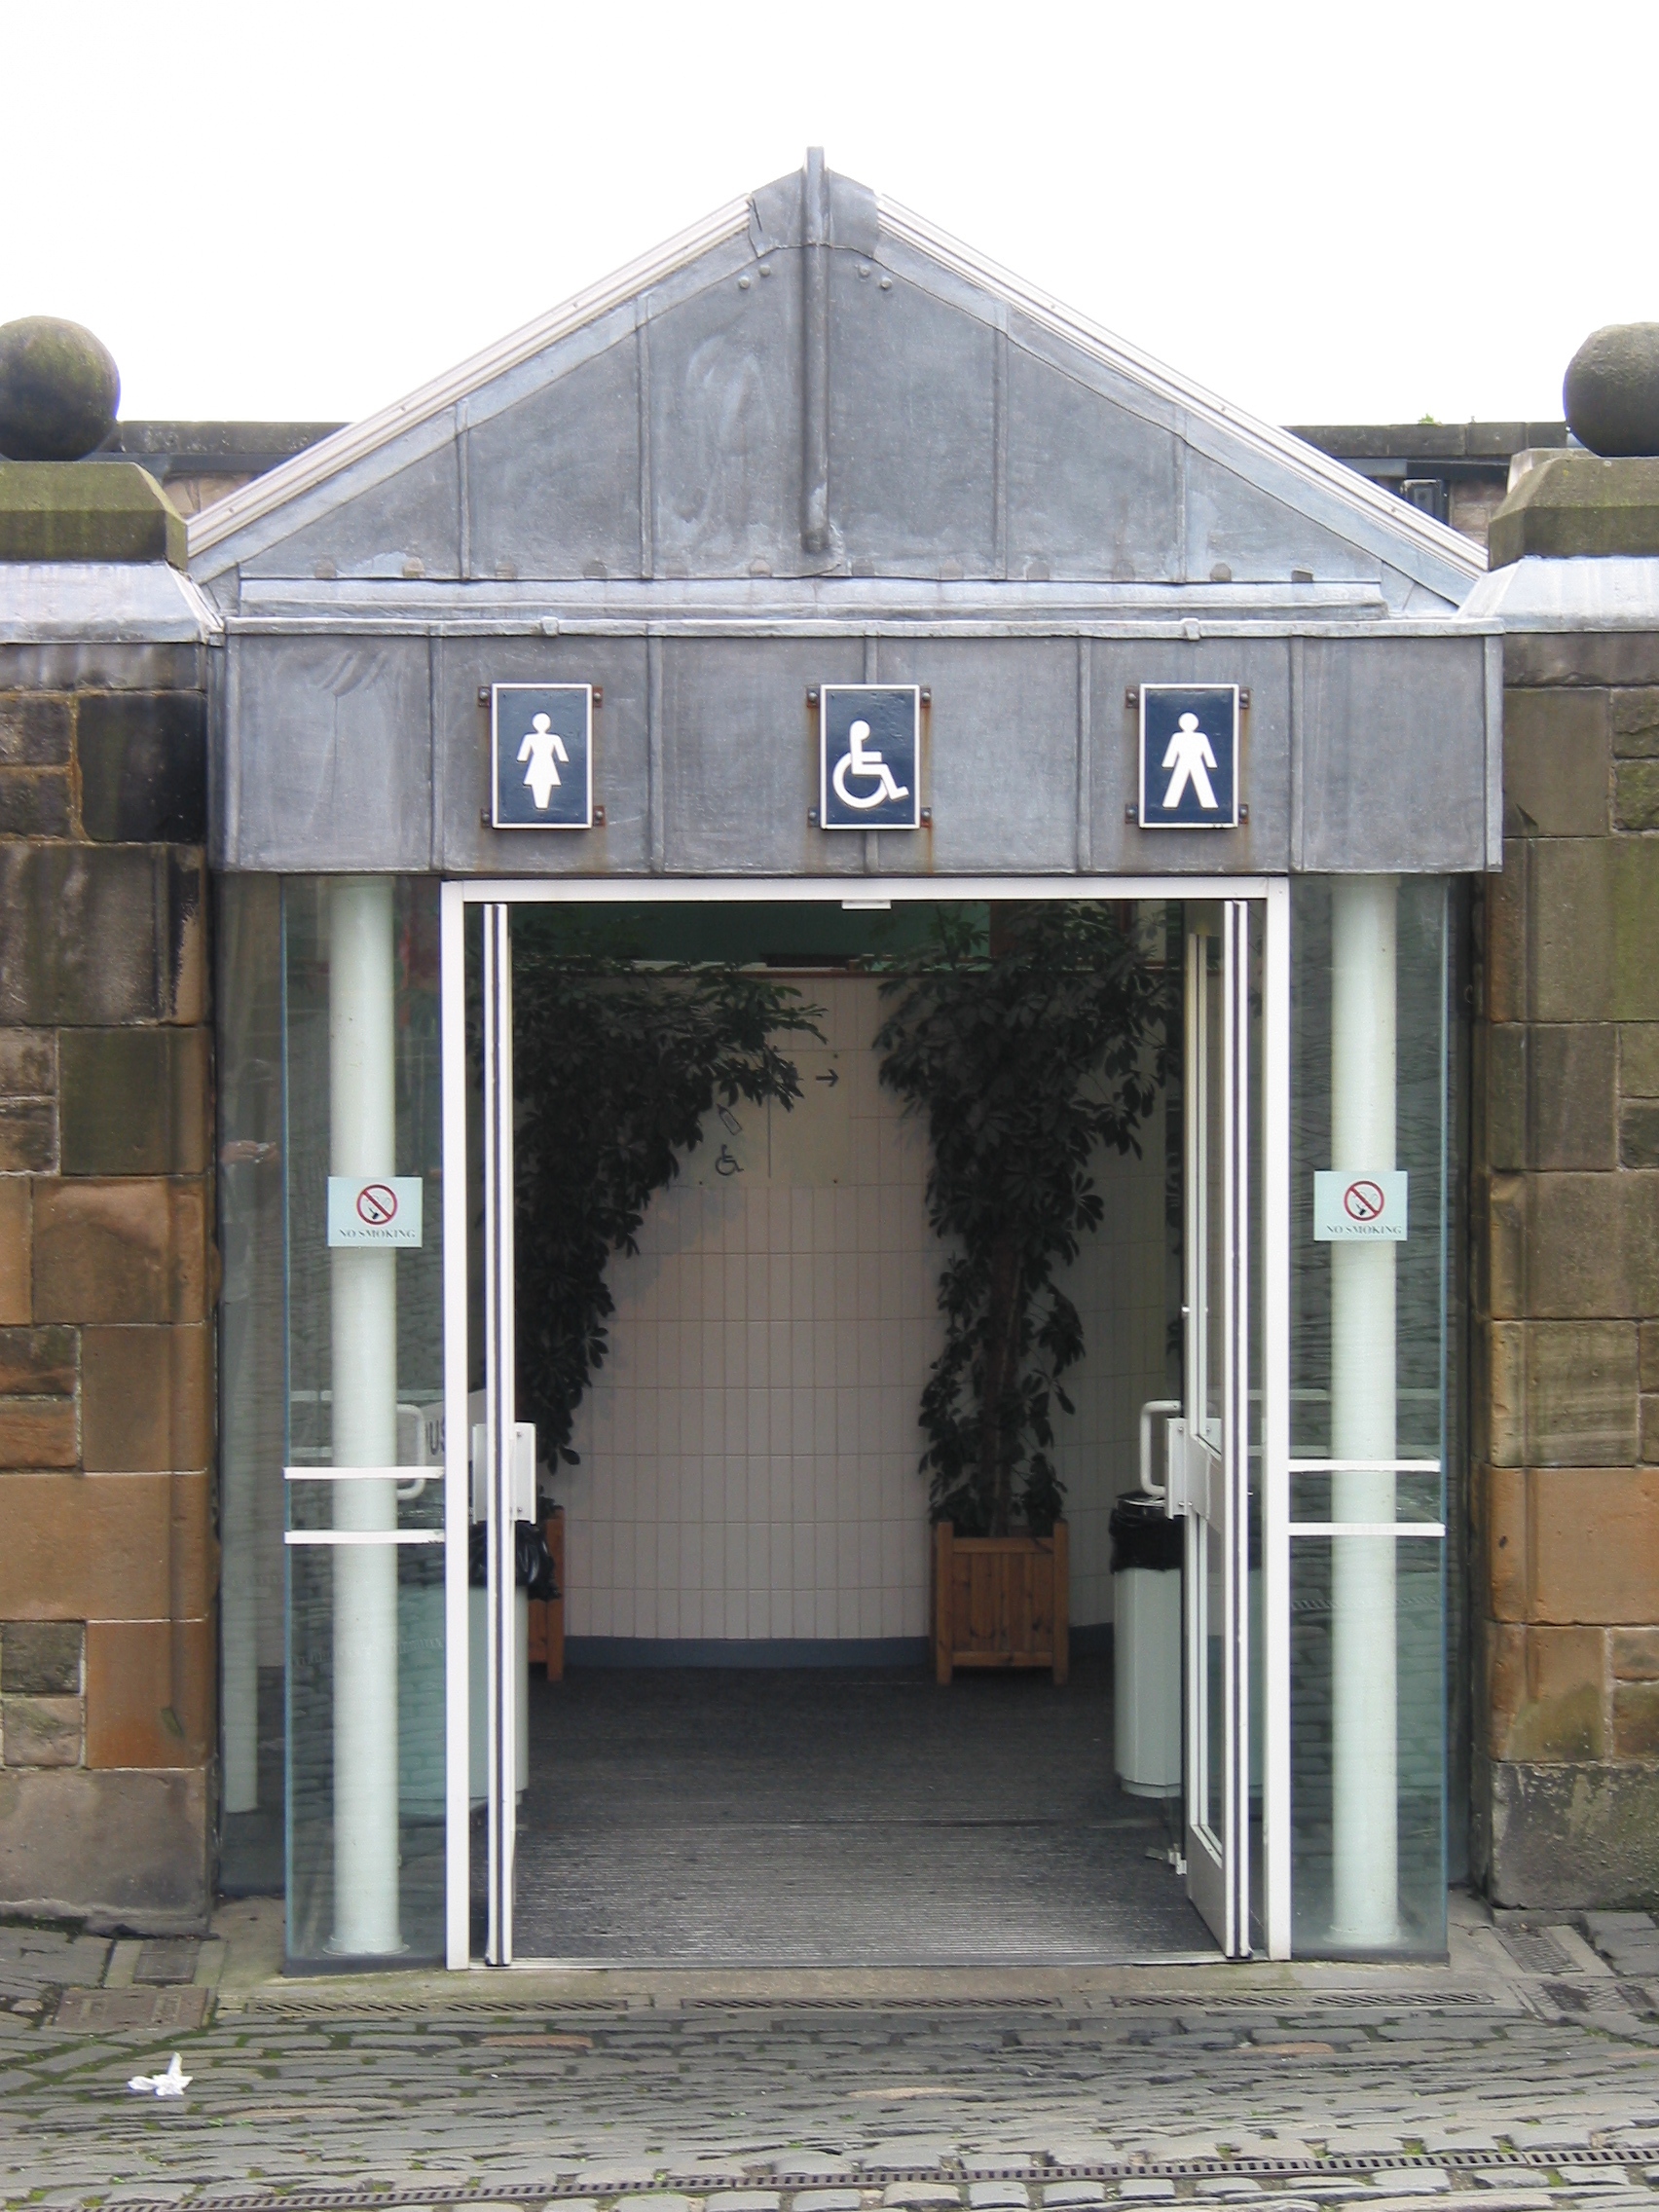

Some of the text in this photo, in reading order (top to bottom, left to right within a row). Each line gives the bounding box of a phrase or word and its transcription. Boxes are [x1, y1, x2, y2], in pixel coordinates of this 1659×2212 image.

[339, 1229, 416, 1238] NO SMOKING
[1326, 1225, 1402, 1235] NO SMOKING
